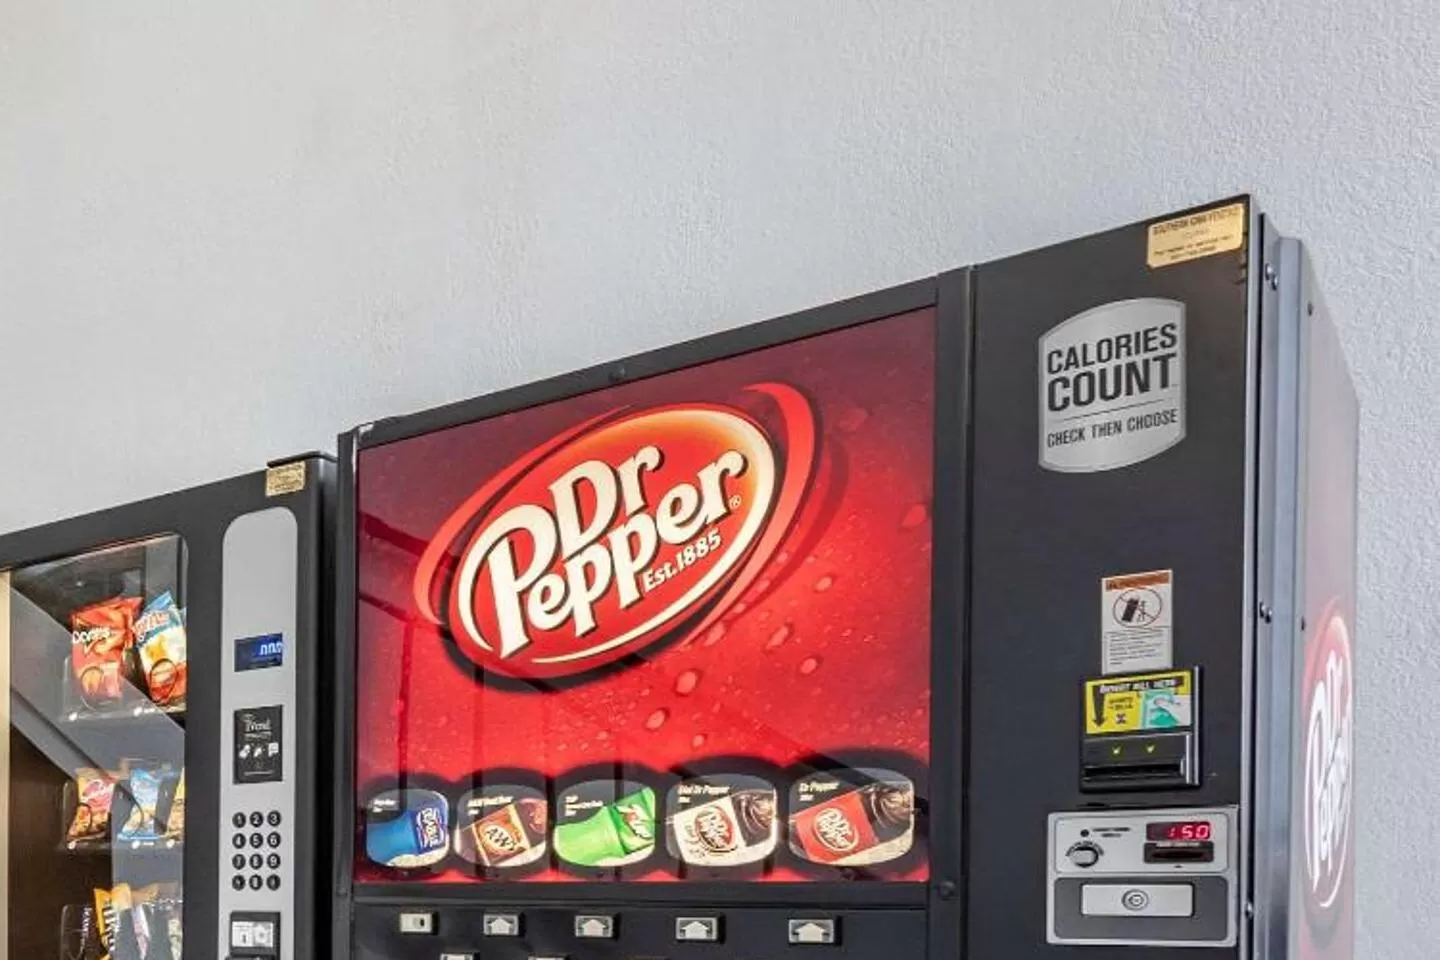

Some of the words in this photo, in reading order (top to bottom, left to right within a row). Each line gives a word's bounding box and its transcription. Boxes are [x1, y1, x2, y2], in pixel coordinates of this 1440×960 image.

[1047, 322, 1177, 375] CALORIES
[1048, 353, 1177, 412] COUNT
[1047, 426, 1086, 448] CHECK
[1092, 420, 1122, 439] THEN
[1127, 408, 1178, 431] CHOOSE
[549, 445, 661, 559] Dr
[458, 450, 744, 658] Pepper
